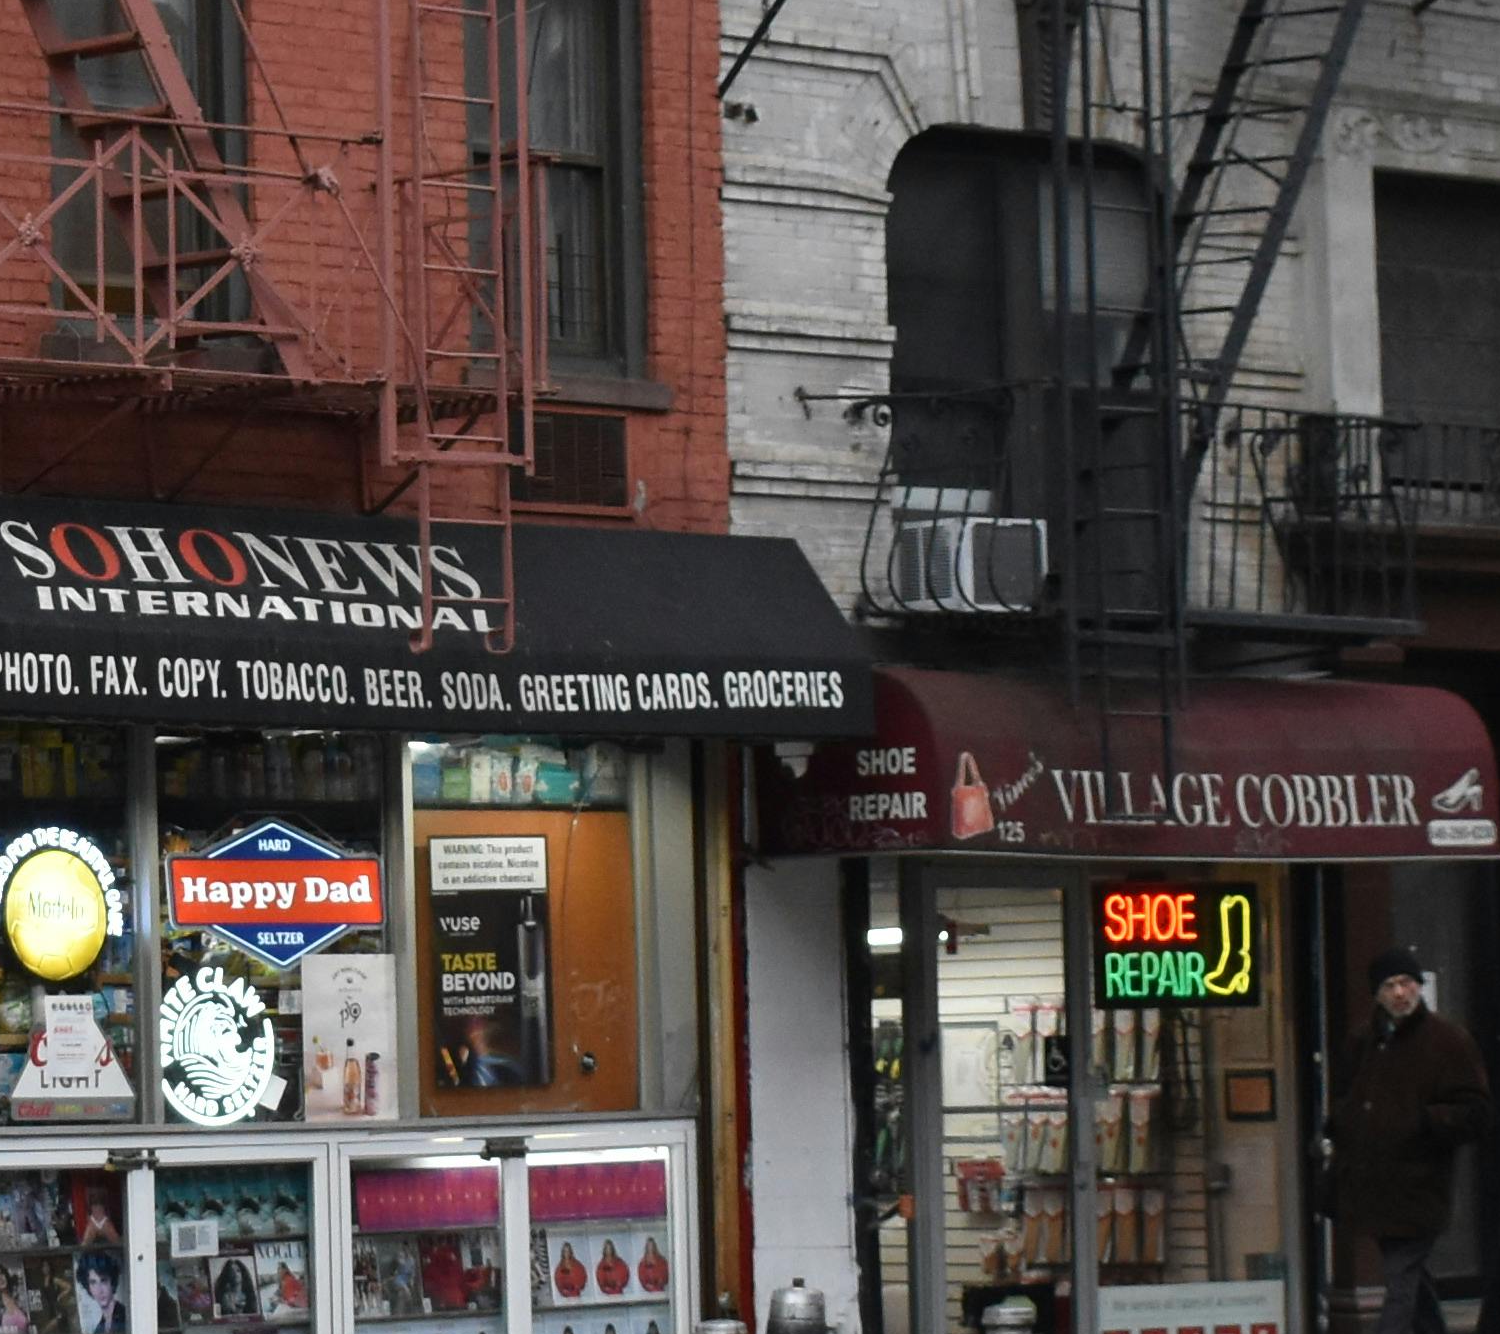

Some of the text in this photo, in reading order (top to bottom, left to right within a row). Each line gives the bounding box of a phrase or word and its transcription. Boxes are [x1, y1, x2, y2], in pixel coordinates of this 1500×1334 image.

[38, 586, 495, 632] INTERNATIONAL
[90, 656, 147, 697] FAX.
[158, 657, 227, 699] COPY.
[238, 660, 355, 705] TOBACCO.
[364, 667, 432, 709] BEER.
[441, 671, 511, 711] SODA.
[519, 673, 630, 712] GREETING
[636, 672, 718, 711] CARDS.
[724, 670, 843, 708] GROCERIES
[856, 747, 916, 776] SHOE
[850, 791, 928, 821] REPAIR
[1051, 769, 1420, 828] VILLAGE COBBLER
[258, 839, 291, 852] HARD
[997, 821, 1025, 843] 125
[181, 875, 372, 909] Happy Dad
[1104, 894, 1198, 942] SHOE
[257, 932, 304, 945] SELTZER
[441, 953, 497, 972] TASTE
[1104, 950, 1207, 998] REPAIR
[442, 971, 515, 992] BEYOND
[160, 975, 197, 1067] WHITE
[196, 967, 266, 1018] CLAW
[174, 1081, 219, 1116] HARD
